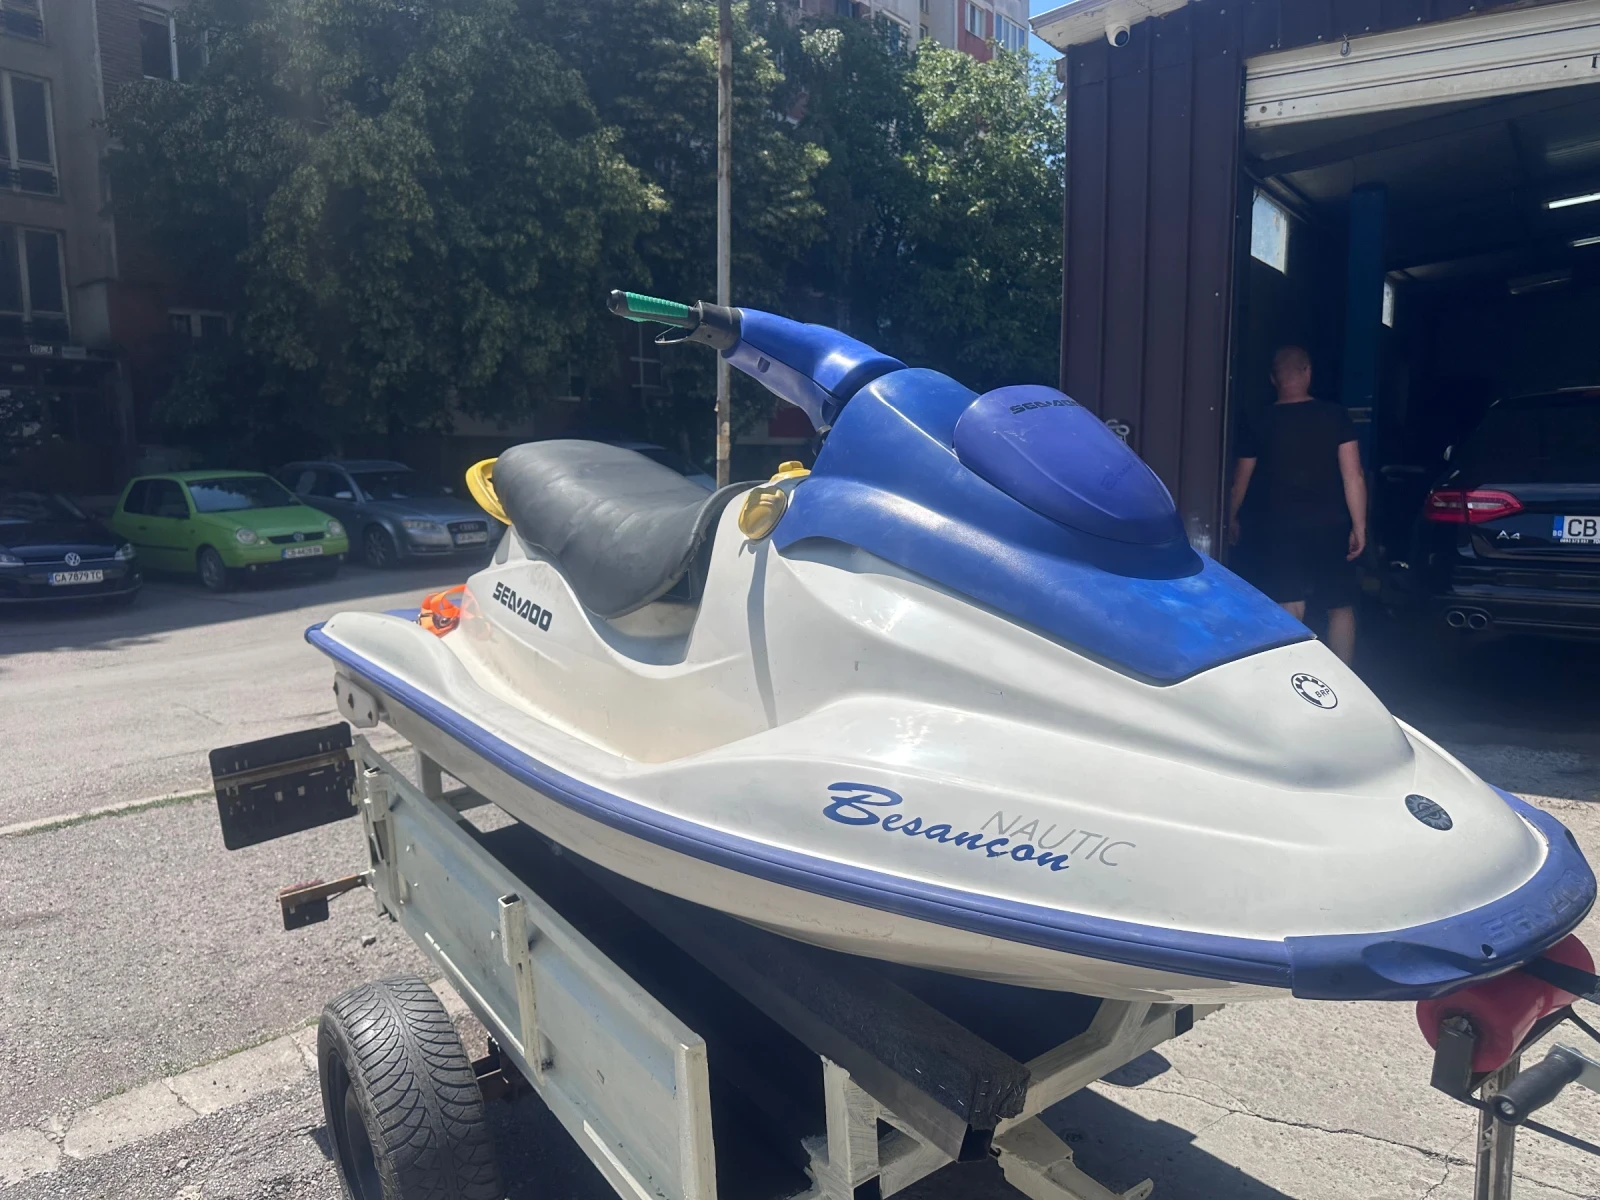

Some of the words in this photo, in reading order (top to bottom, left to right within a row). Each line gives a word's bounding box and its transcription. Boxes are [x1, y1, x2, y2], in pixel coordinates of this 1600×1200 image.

[1567, 518, 1597, 537] CB
[1496, 530, 1521, 540] A4
[54, 573, 67, 583] CA
[1314, 688, 1331, 698] BRP
[822, 782, 1070, 871] Besançon
[980, 810, 1137, 867] NAUTIC
